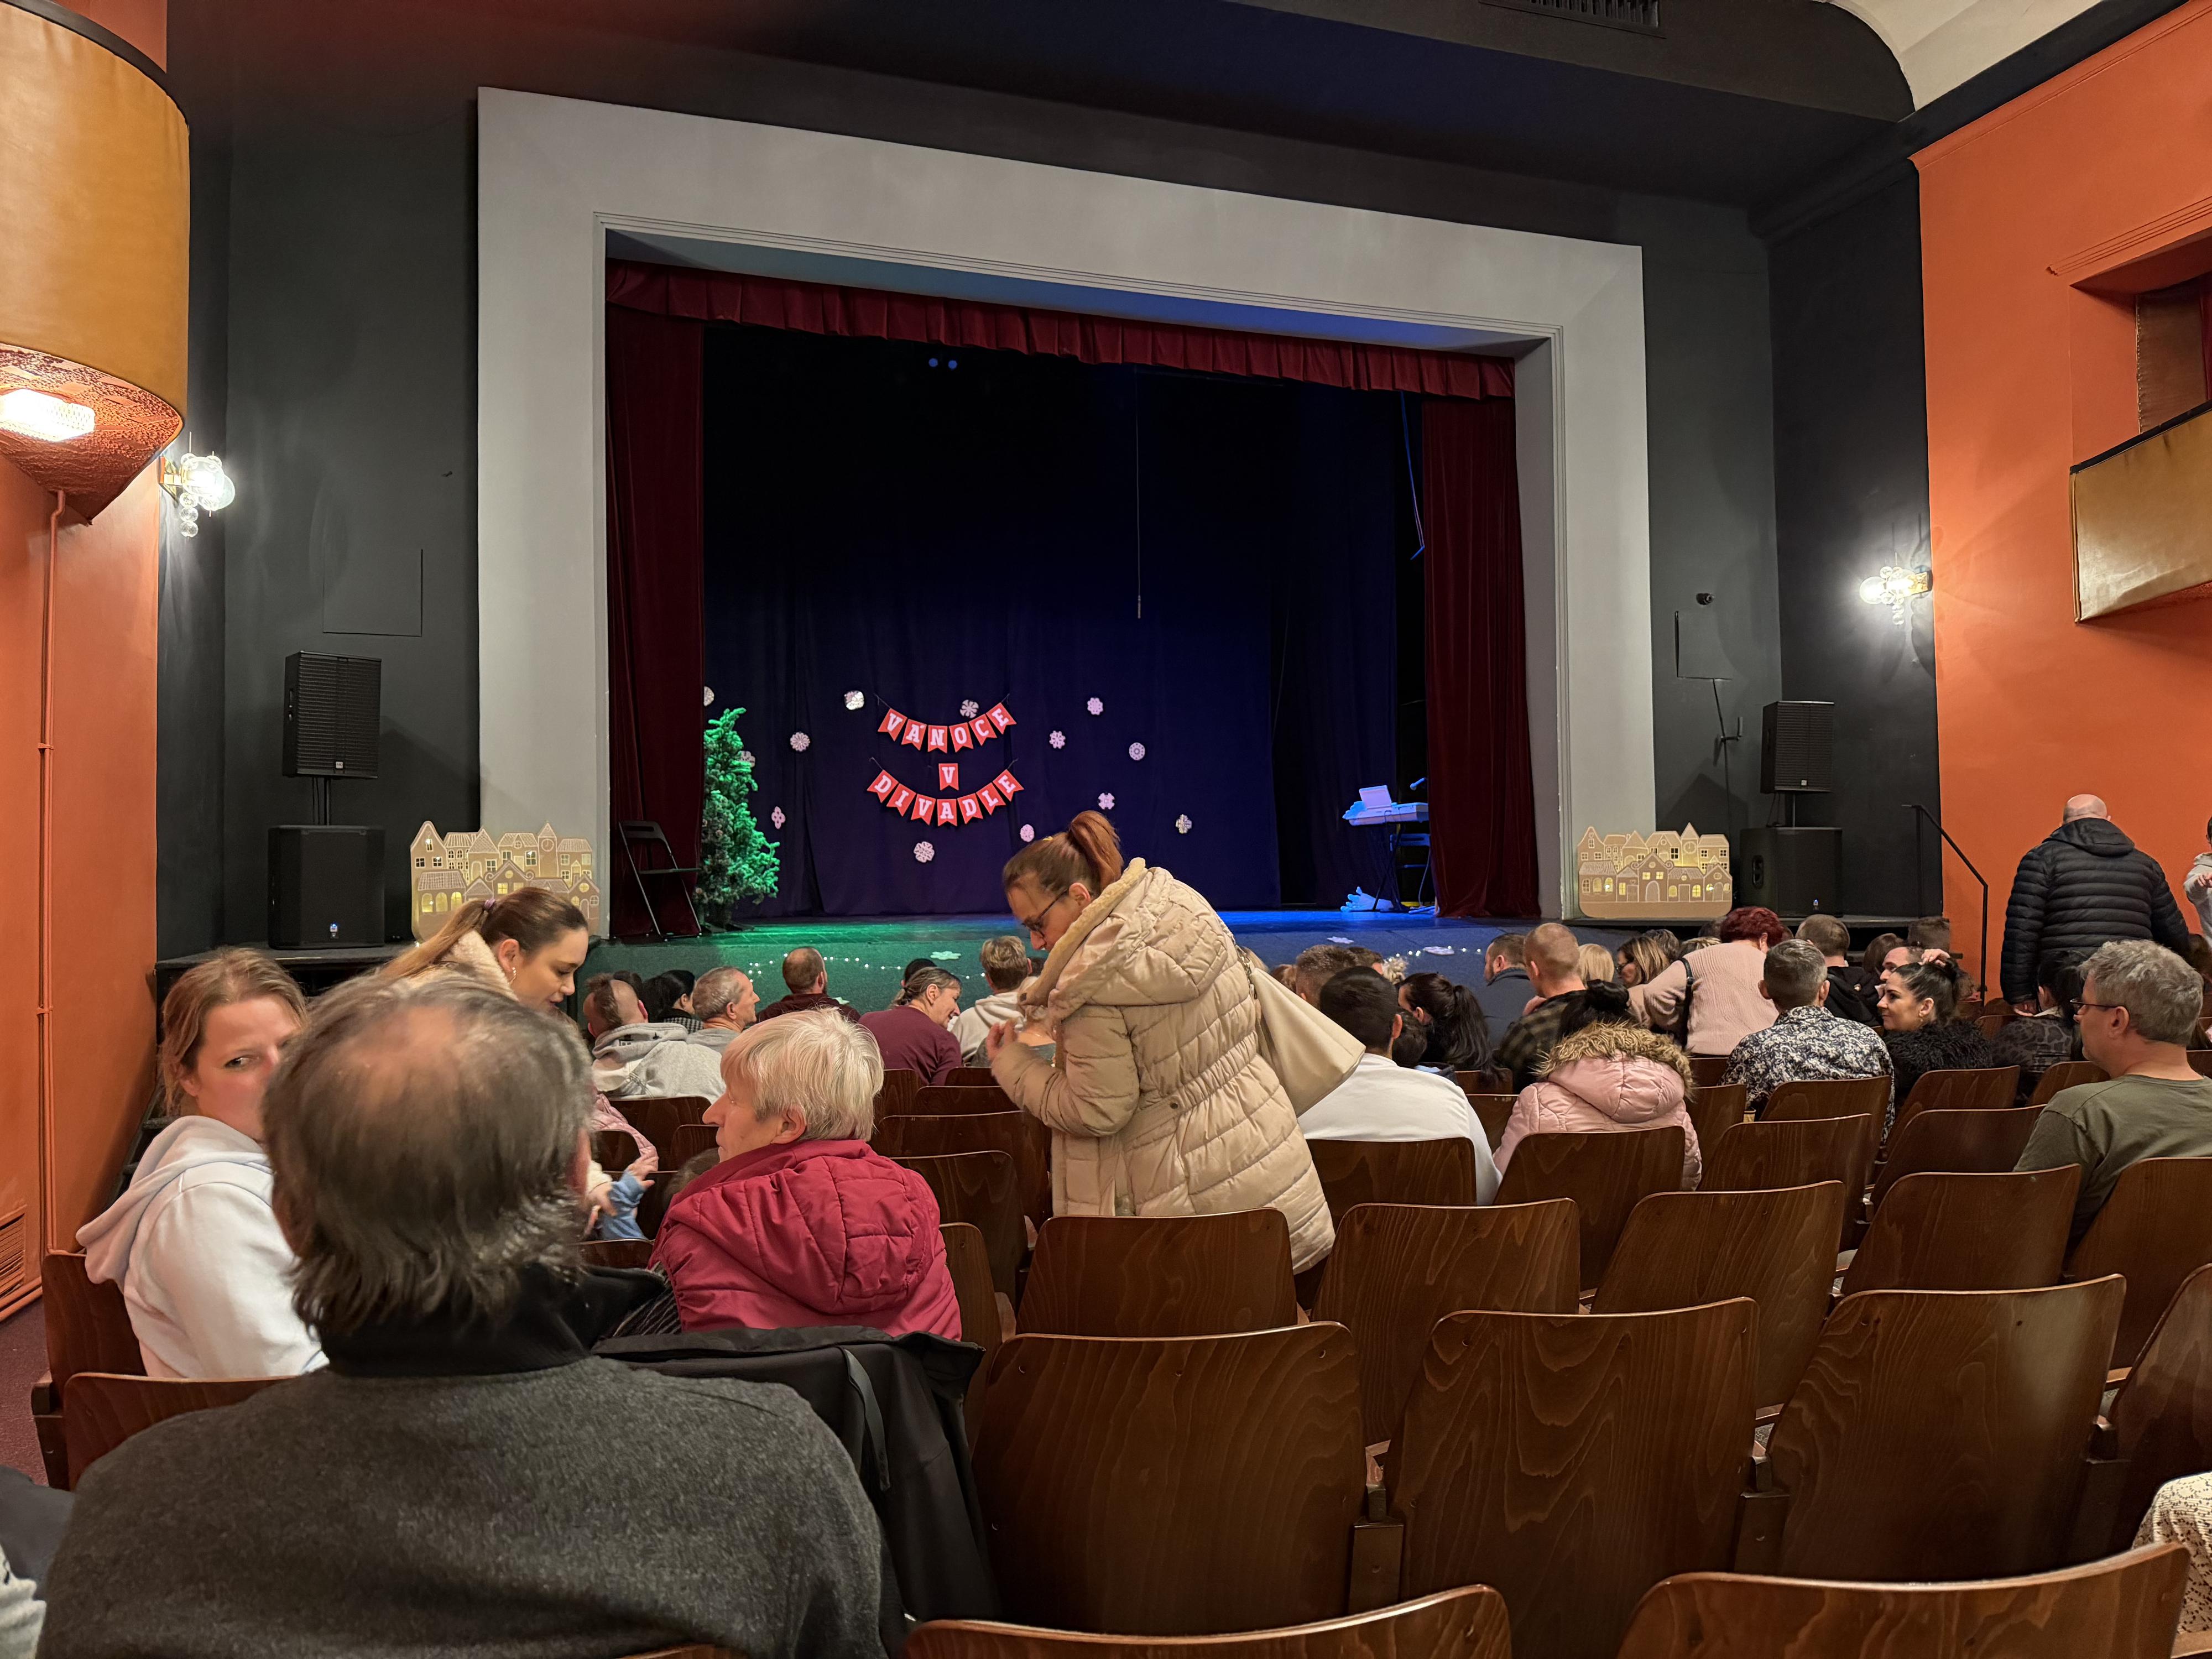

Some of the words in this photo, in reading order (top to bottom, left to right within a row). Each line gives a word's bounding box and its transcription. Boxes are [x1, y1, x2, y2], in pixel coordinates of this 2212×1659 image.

[887, 708, 1009, 746] VÁNOCE
[941, 766, 956, 784] V
[874, 775, 1016, 819] DIVADLE
